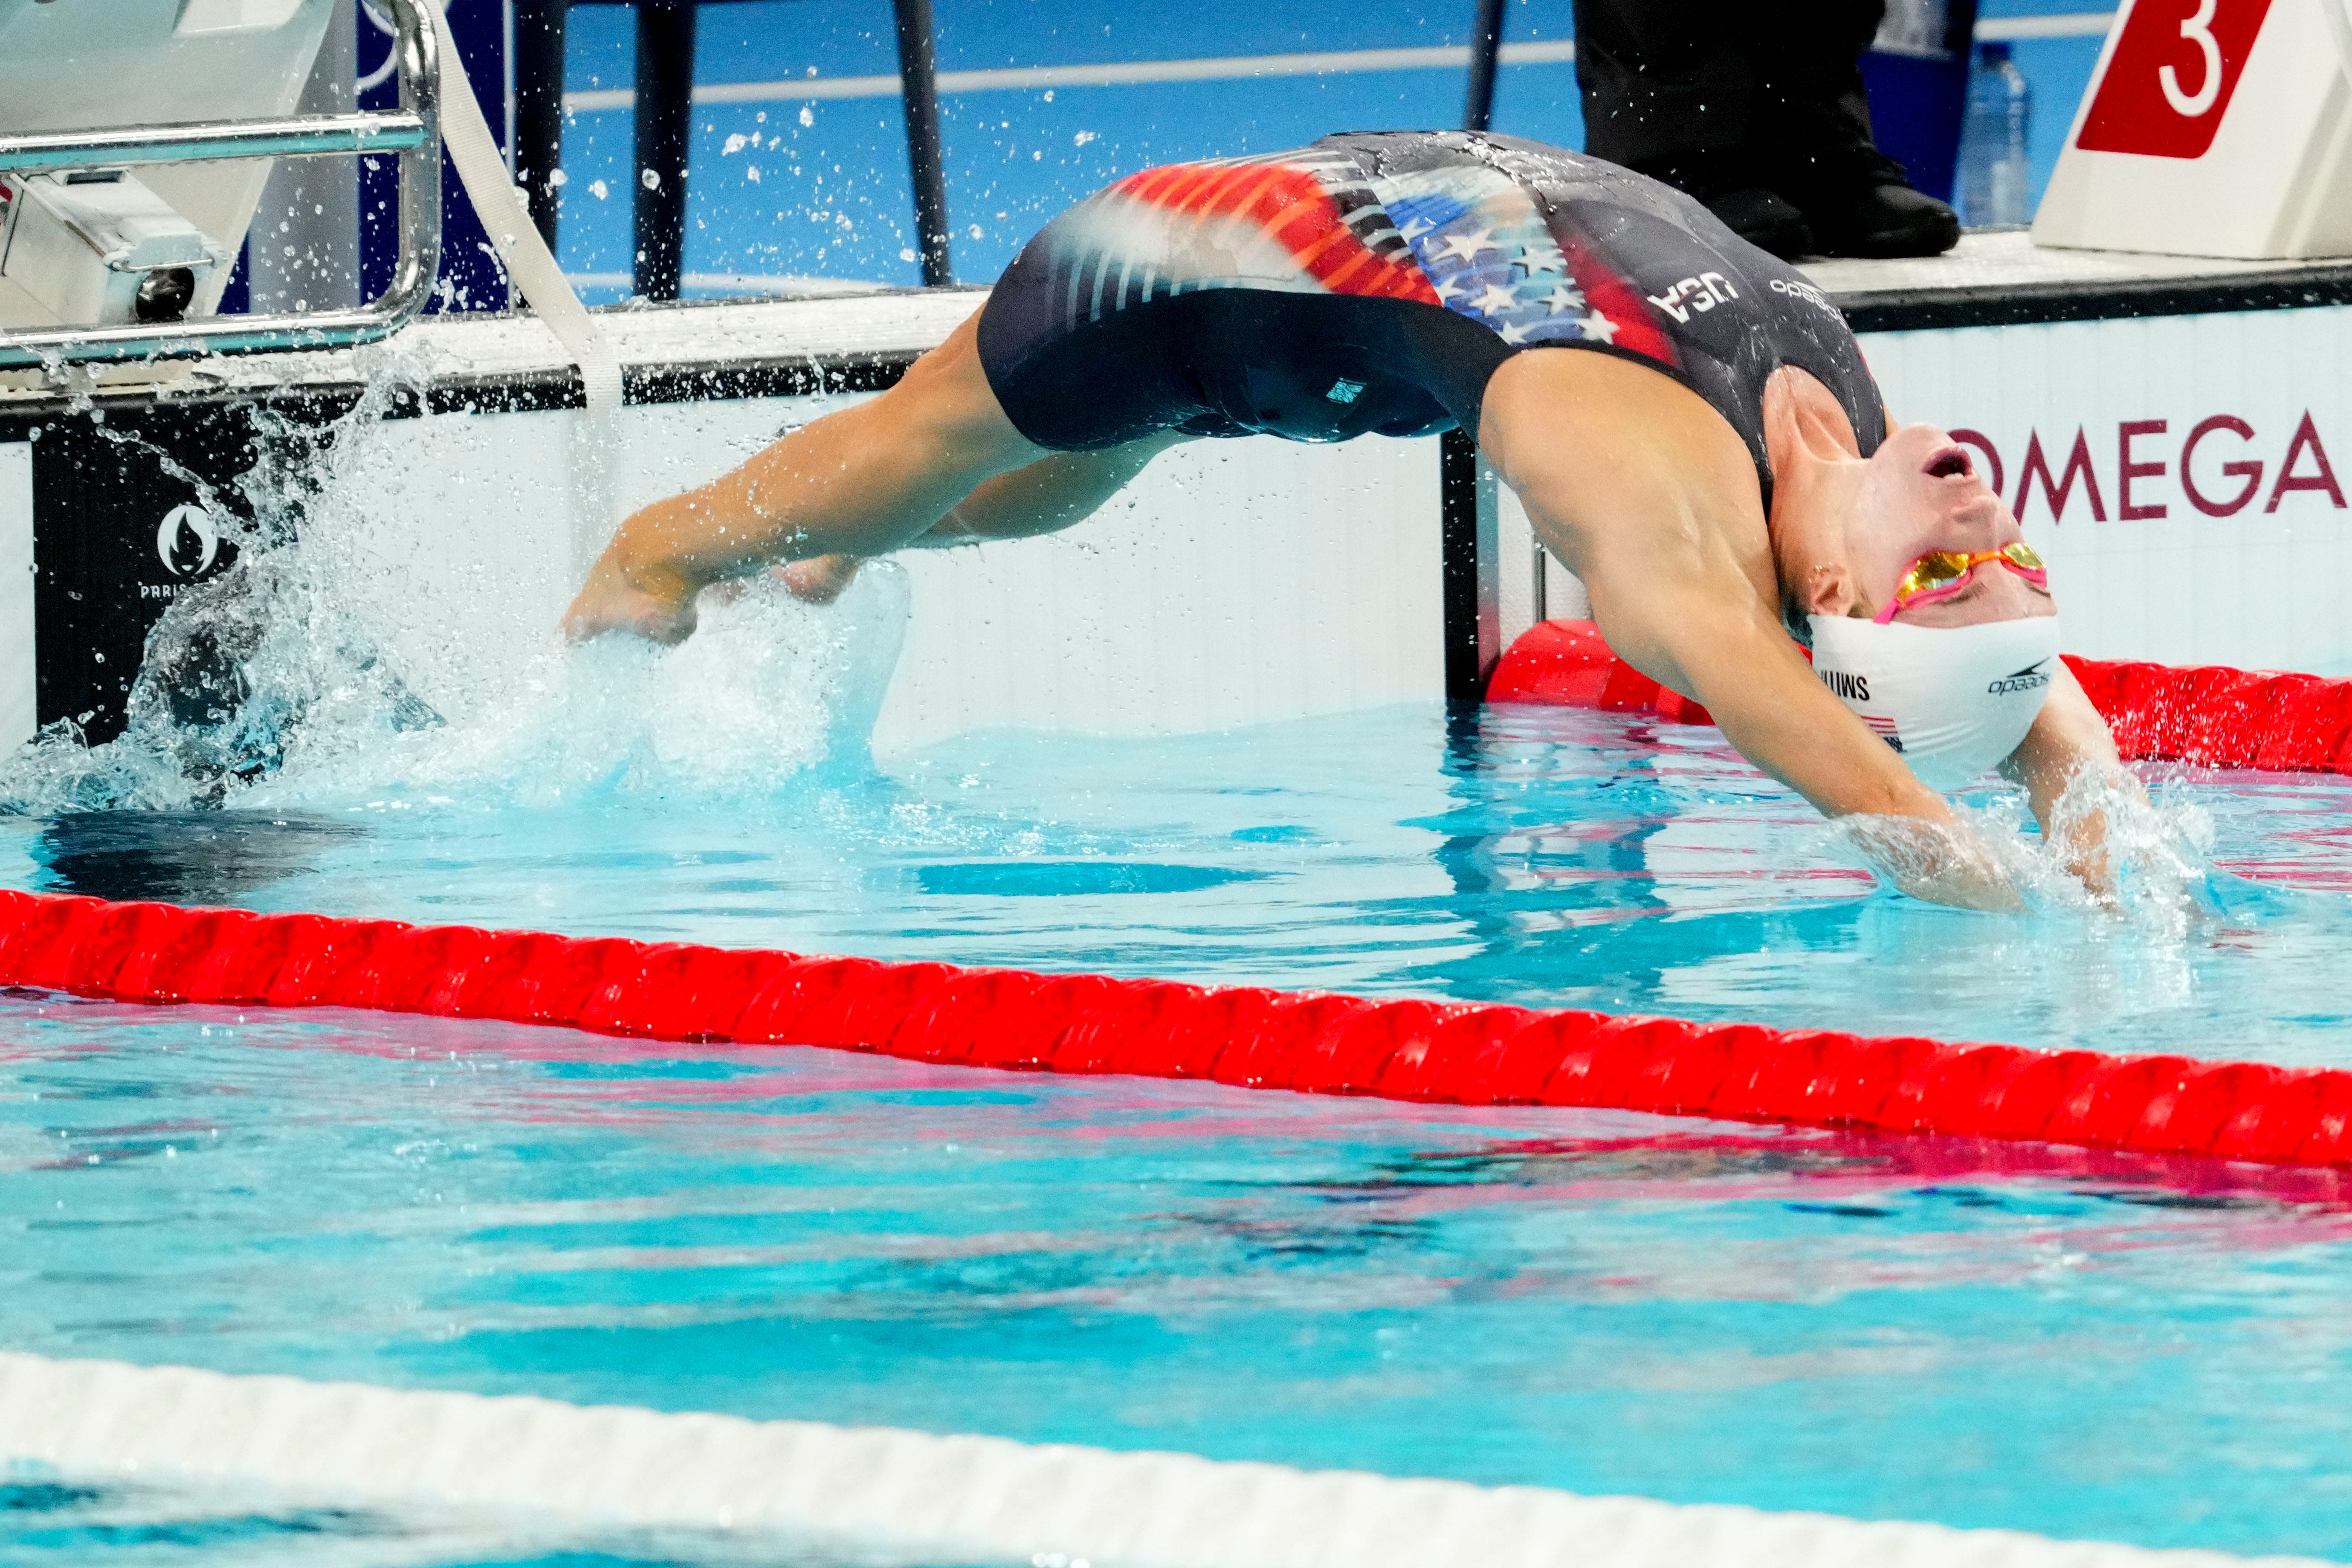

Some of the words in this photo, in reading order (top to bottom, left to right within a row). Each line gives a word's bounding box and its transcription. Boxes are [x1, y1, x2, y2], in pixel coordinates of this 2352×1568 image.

[2158, 0, 2222, 117] 3
[1646, 272, 1739, 324] USA
[1770, 279, 1848, 330] speedo
